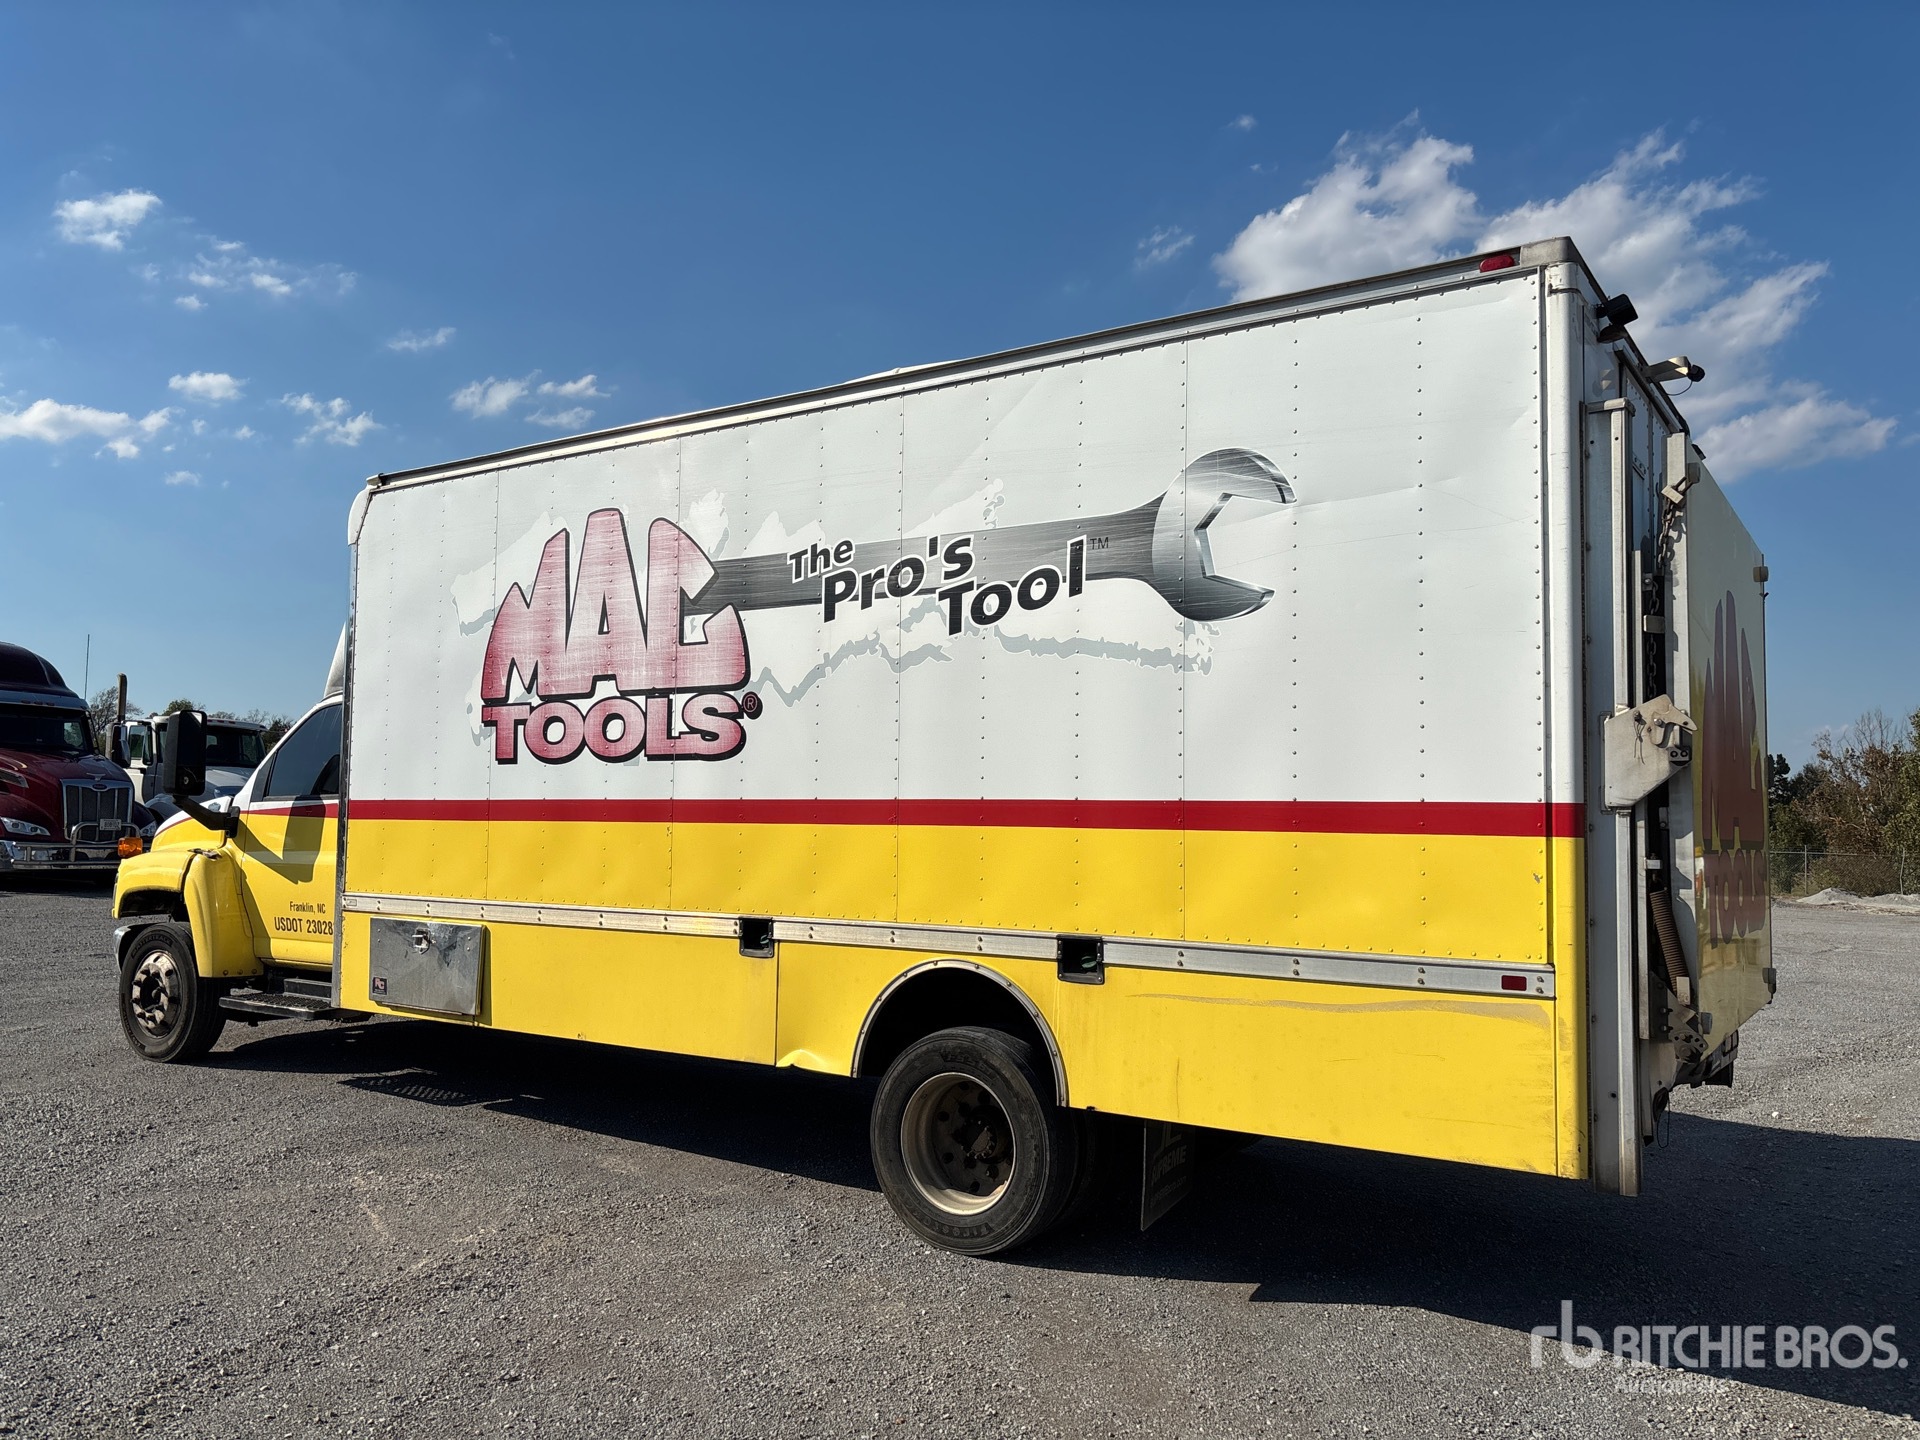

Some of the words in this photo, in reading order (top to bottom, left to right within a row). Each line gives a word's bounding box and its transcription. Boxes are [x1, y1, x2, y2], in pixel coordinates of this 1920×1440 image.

[788, 540, 854, 581] The
[823, 535, 973, 622] Pro's
[938, 538, 1085, 636] Tool
[481, 507, 750, 702] MAC
[482, 691, 746, 764] TOOLS
[1702, 590, 1765, 851] MAC
[274, 916, 303, 932] USDOT
[306, 919, 334, 935] 23028
[289, 900, 316, 915] Franklin,
[317, 902, 326, 914] NC
[1703, 848, 1767, 950] TOOLS
